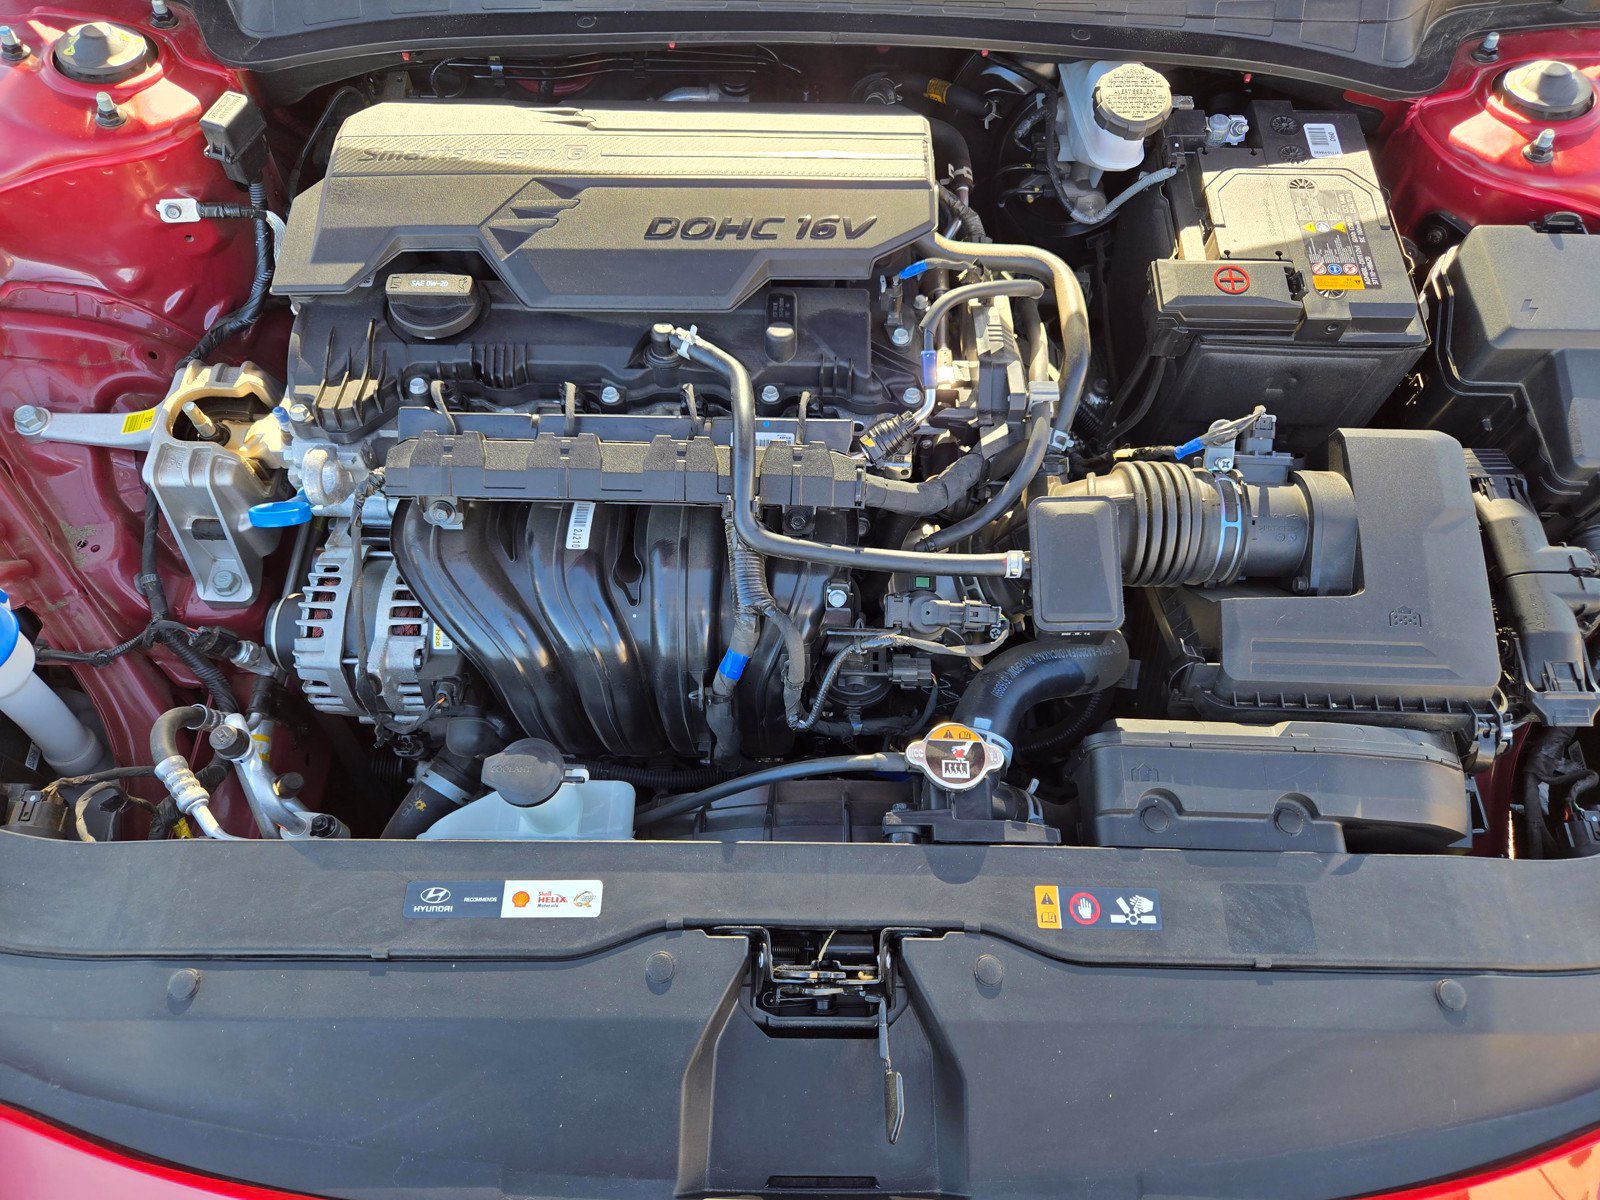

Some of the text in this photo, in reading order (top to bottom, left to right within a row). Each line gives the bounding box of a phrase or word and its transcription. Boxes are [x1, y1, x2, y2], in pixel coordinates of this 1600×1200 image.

[357, 146, 556, 162] Smartstream
[643, 214, 878, 240] DOHC 16V
[571, 528, 583, 549] 2J210
